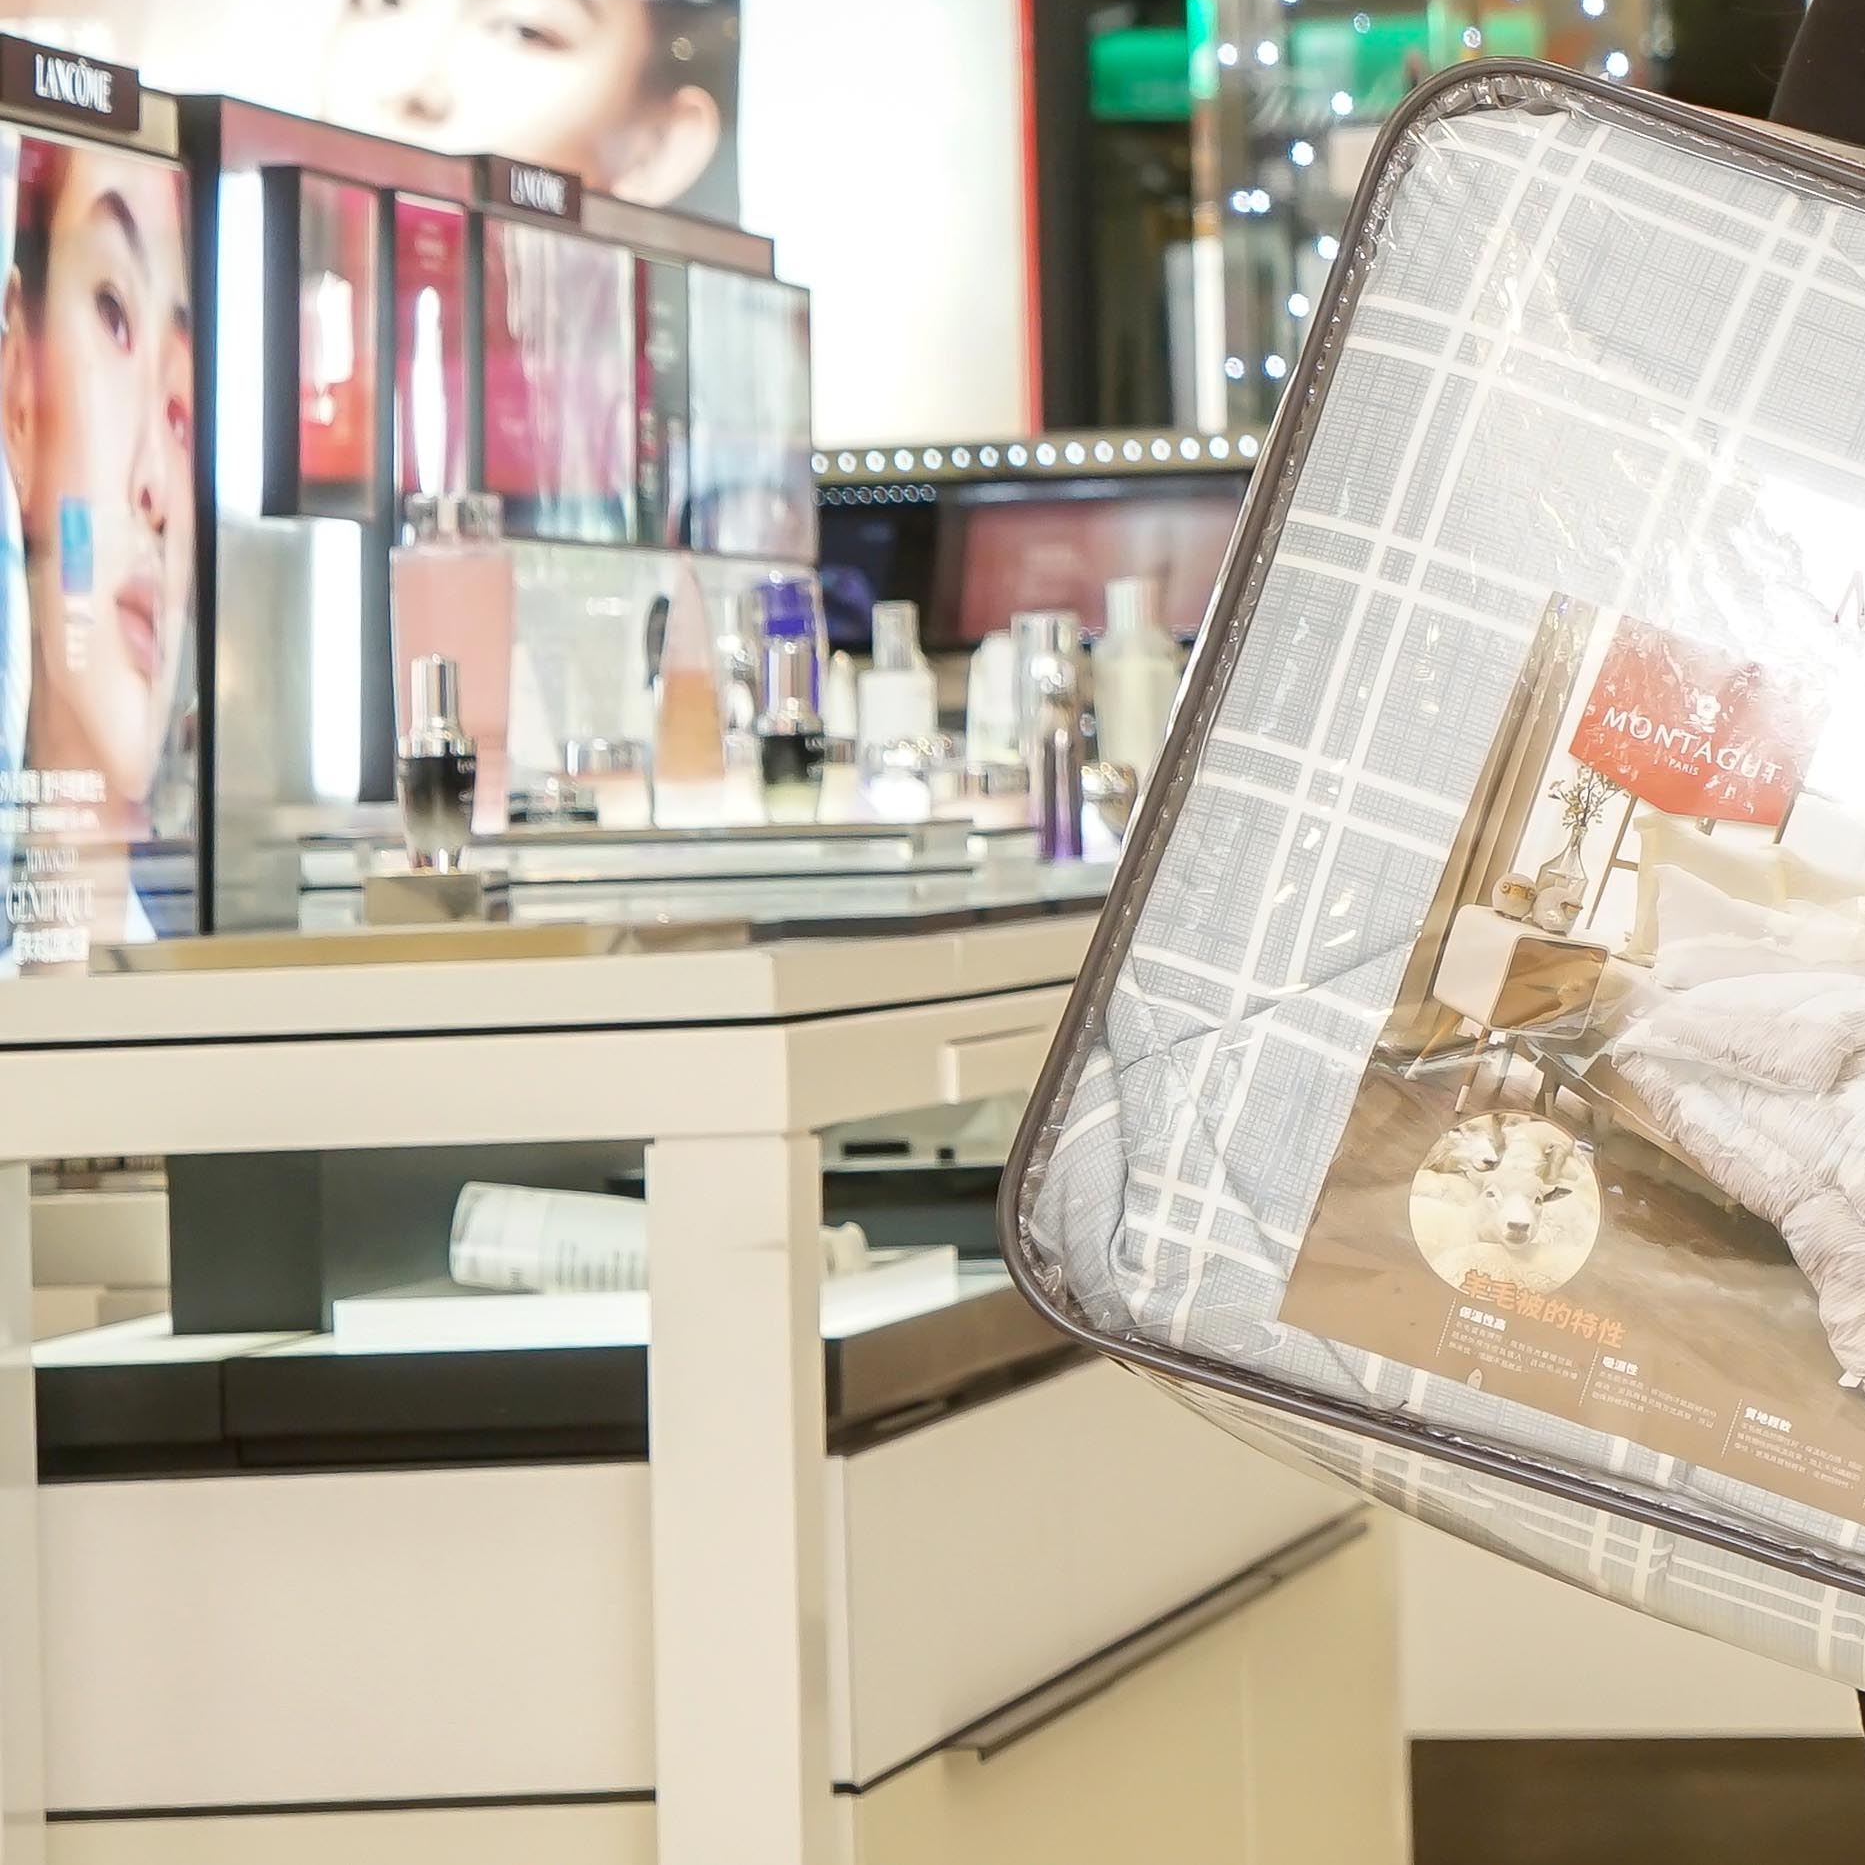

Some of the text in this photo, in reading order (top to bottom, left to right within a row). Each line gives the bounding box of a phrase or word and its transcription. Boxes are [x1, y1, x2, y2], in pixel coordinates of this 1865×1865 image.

[34, 52, 113, 114] LANCÔME
[1600, 705, 1784, 785] MONTAGUT
[1667, 757, 1701, 777] PARIS
[1460, 1268, 1627, 1348] 羊毛被的特性
